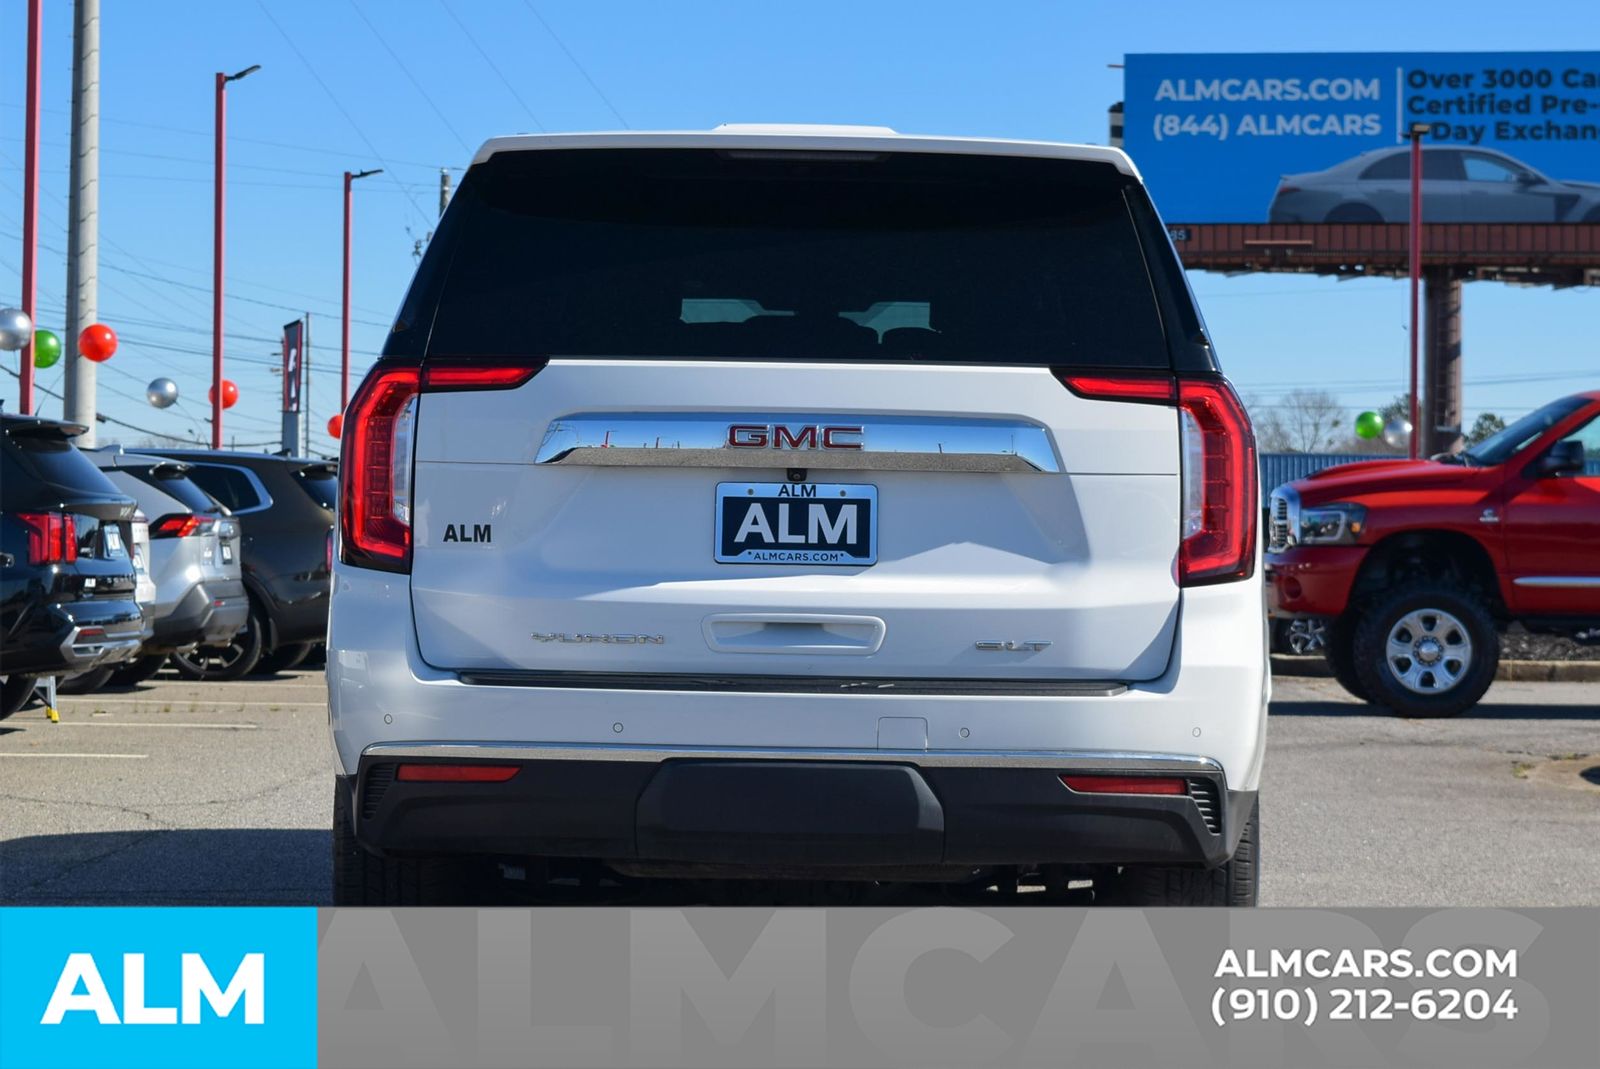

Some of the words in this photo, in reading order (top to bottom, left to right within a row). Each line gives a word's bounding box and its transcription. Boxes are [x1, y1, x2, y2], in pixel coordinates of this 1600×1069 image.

[1155, 78, 1380, 101] ALMCARS.COM
[1407, 69, 1474, 89] Over
[1482, 69, 1553, 89] 3000
[1562, 68, 1600, 89] Ca
[1407, 93, 1531, 115] Certified
[1153, 113, 1229, 141] (844)
[1236, 114, 1382, 136] ALMCARS
[1495, 120, 1600, 142] Exchan
[727, 424, 865, 450] GMC
[778, 484, 817, 498] ALM
[443, 524, 491, 543] ALM
[733, 502, 858, 545] ALM
[753, 551, 839, 562] ALMCARS.COM
[975, 639, 1054, 652] SLT
